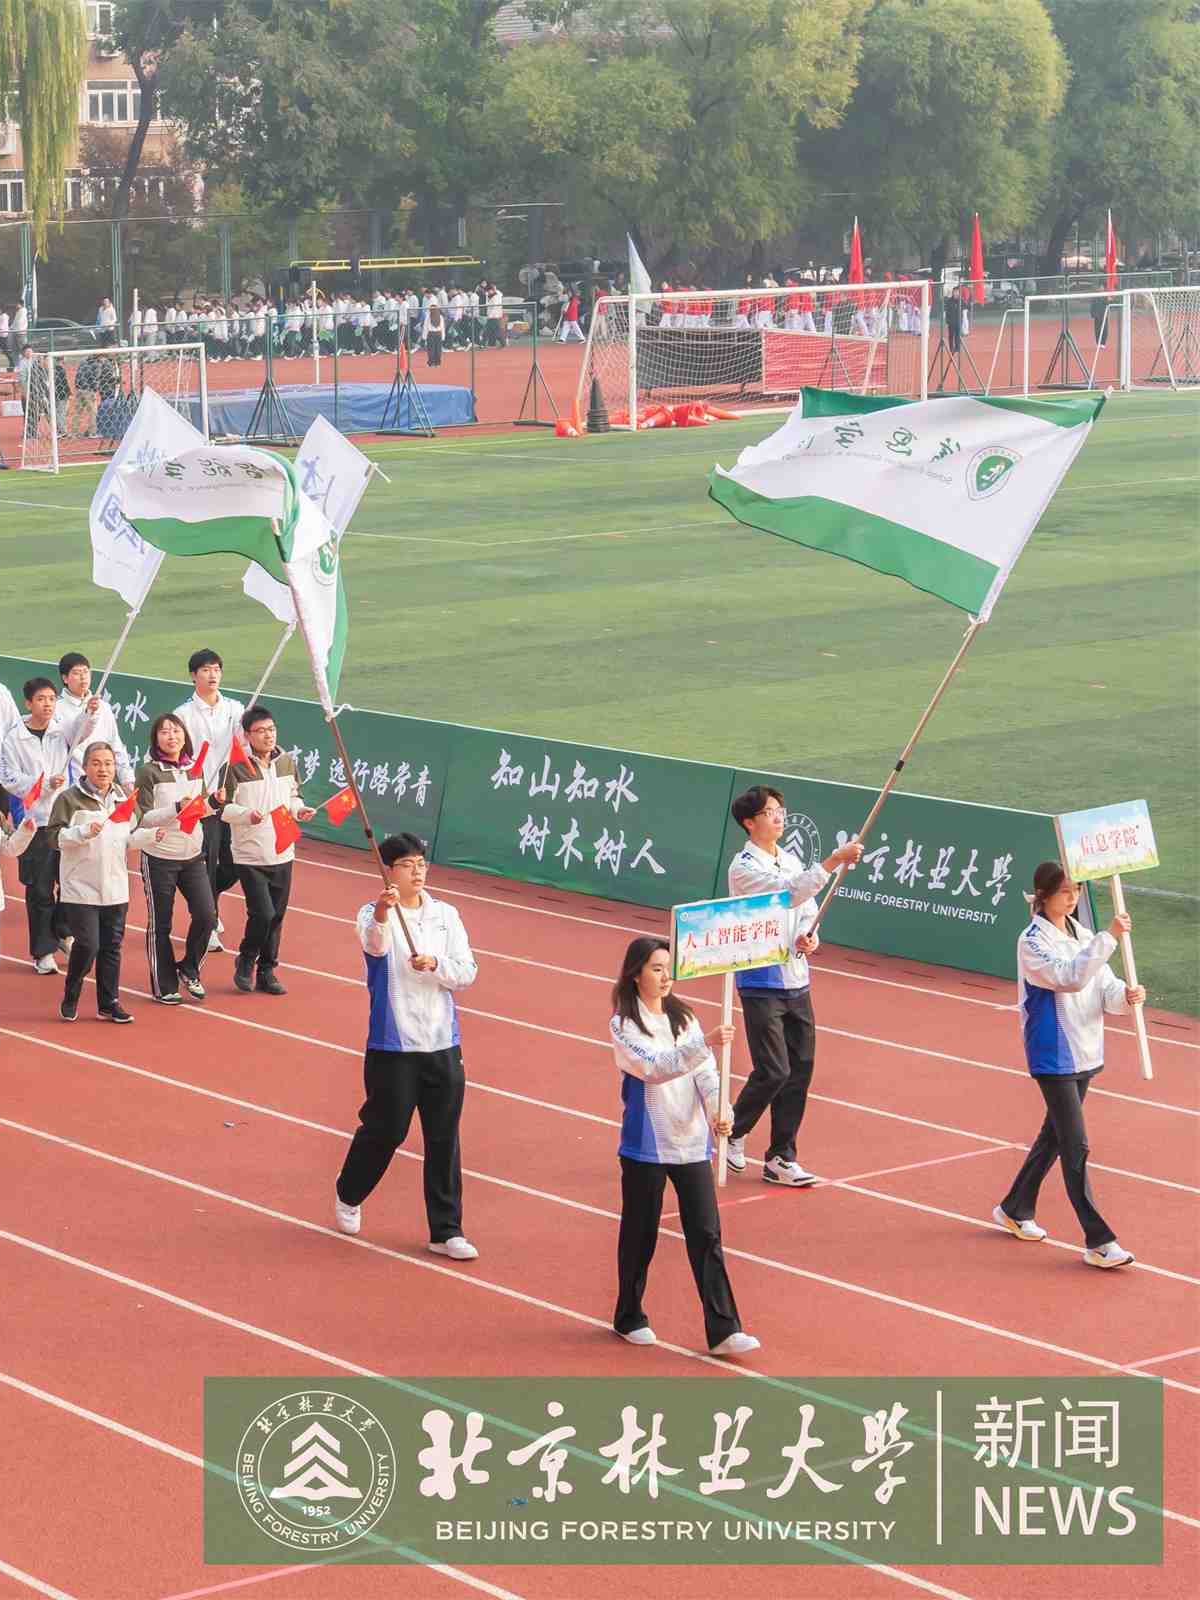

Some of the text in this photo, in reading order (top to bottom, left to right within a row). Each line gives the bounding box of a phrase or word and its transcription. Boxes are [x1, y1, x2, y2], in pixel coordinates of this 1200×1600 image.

[490, 748, 639, 813] 知山知水
[518, 814, 666, 876] 树木树人
[1080, 825, 1138, 857] 信息学院
[873, 893, 930, 912] FORESTRY
[932, 903, 998, 925] UNIVERSITY
[686, 919, 781, 949] 人工智能学院
